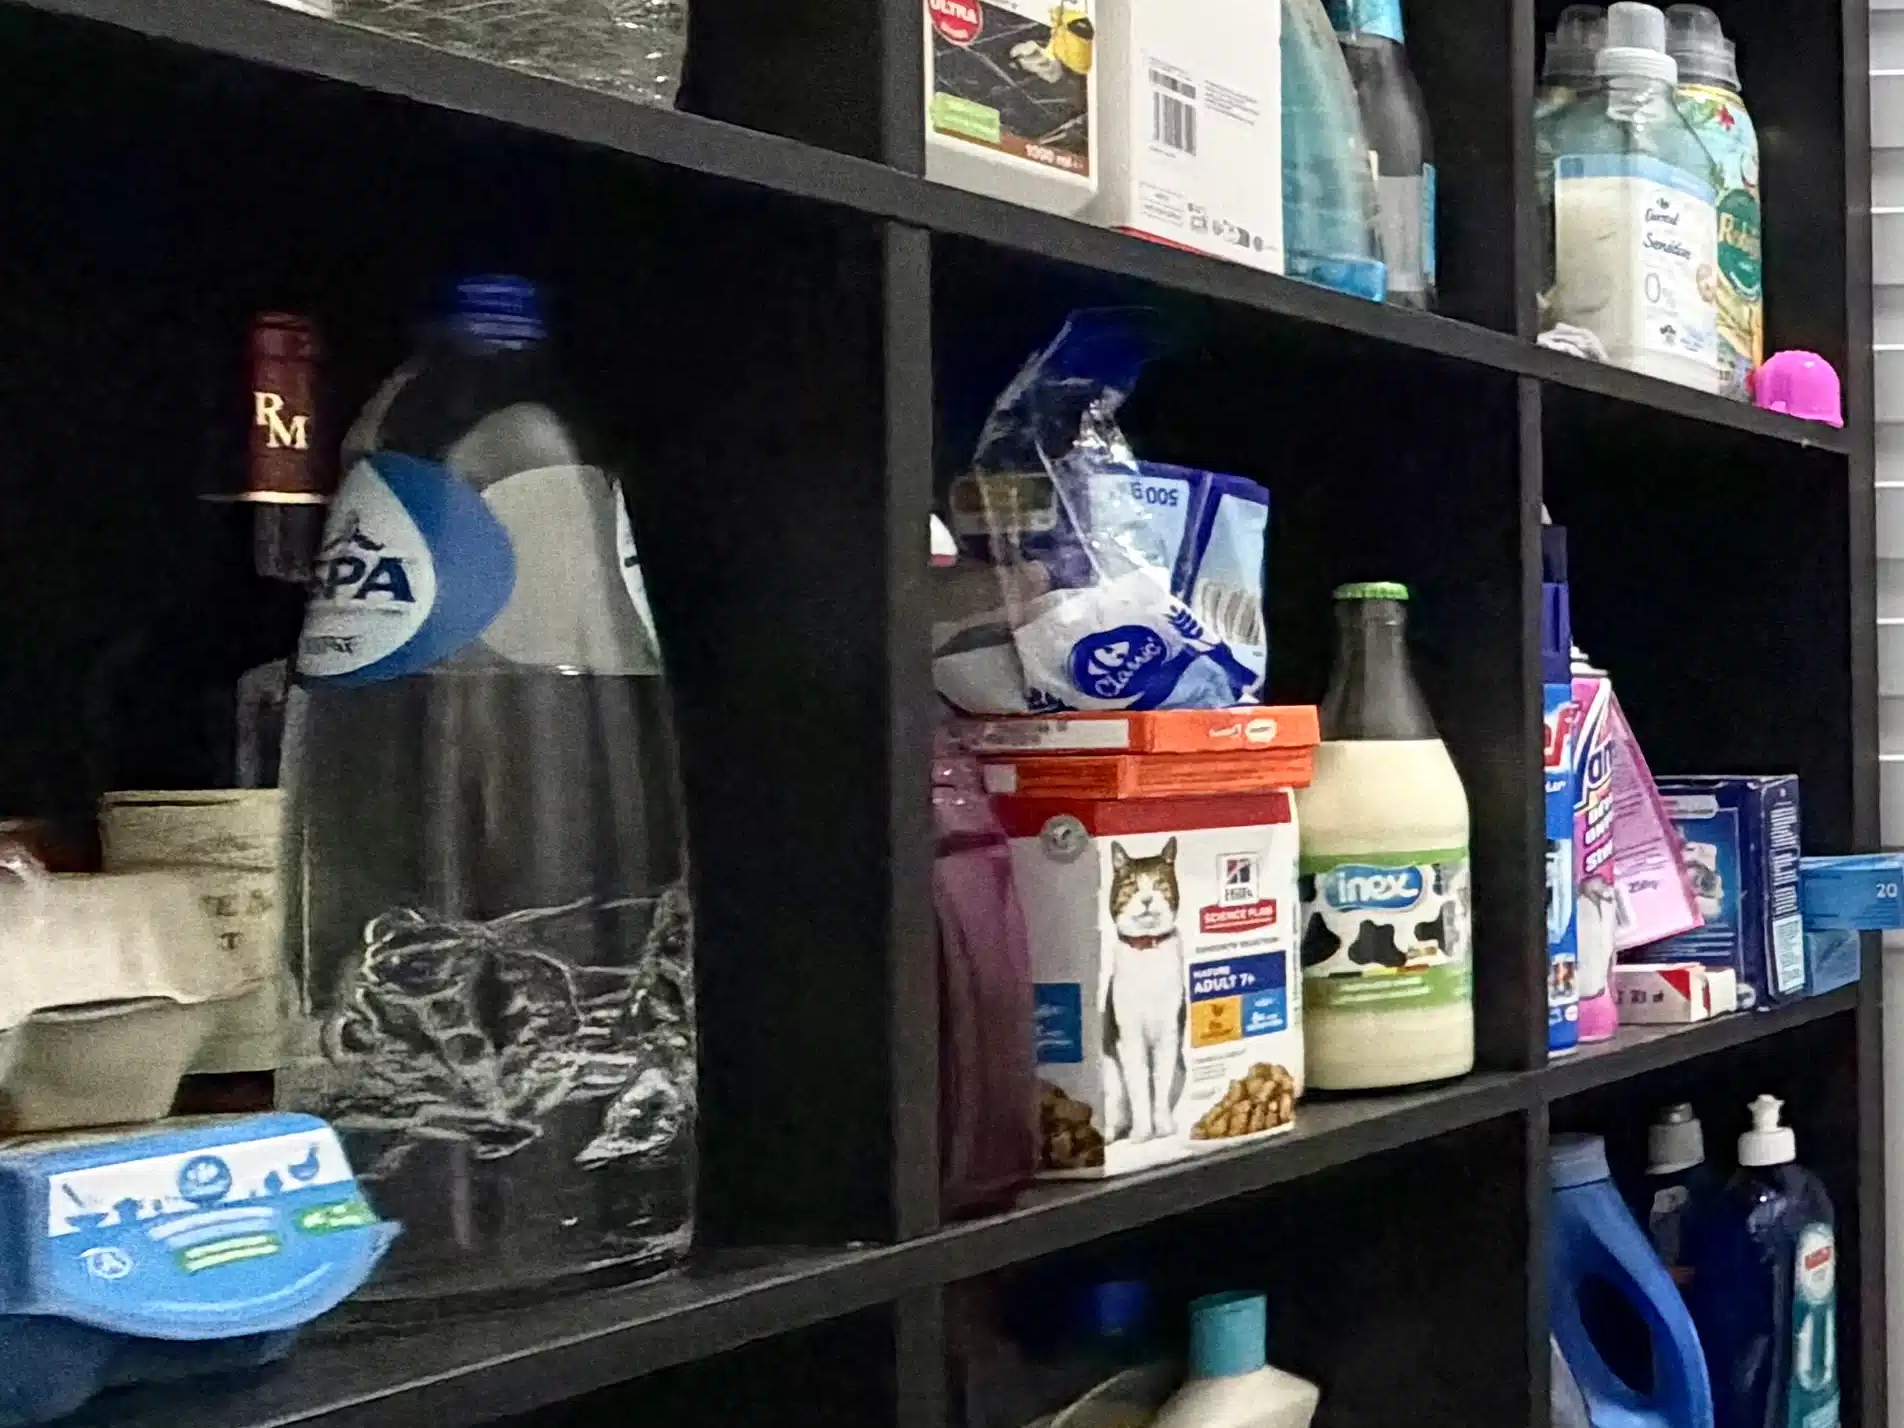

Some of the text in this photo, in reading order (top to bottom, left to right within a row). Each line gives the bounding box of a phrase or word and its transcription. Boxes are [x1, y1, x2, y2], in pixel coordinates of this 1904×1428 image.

[1146, 484, 1179, 508] 500
[1336, 872, 1419, 903] inex
[1875, 882, 1899, 899] 20
[1194, 974, 1238, 995] ADULT
